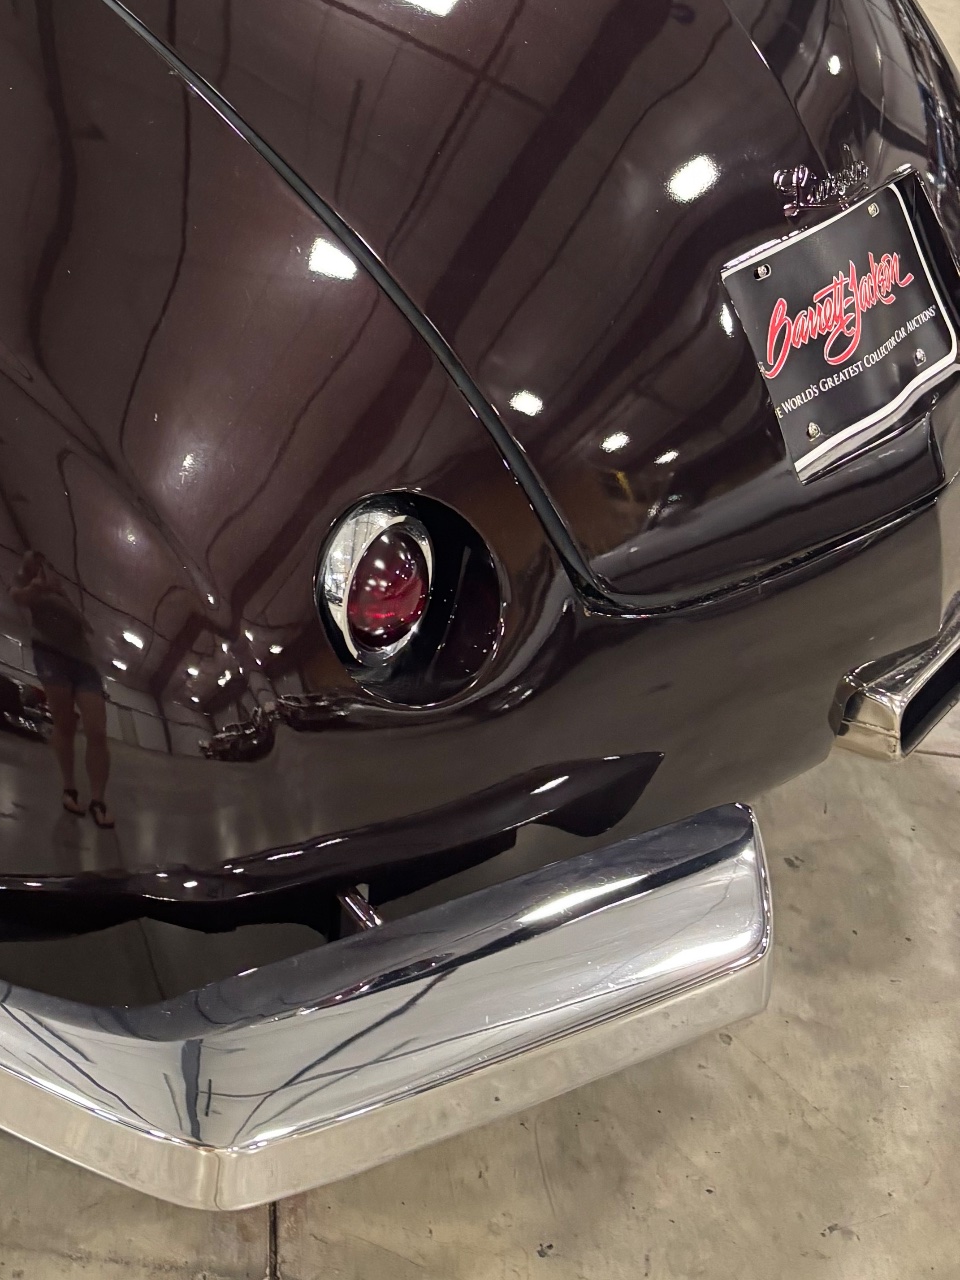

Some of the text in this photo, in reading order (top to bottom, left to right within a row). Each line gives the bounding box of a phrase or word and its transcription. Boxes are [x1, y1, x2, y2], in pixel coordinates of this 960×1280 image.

[765, 251, 915, 379] Barrett-Jackson
[781, 384, 819, 415] WORLD'S
[819, 361, 864, 392] GREATEST
[863, 336, 898, 368] COLLECTOR
[894, 326, 908, 343] CAR
